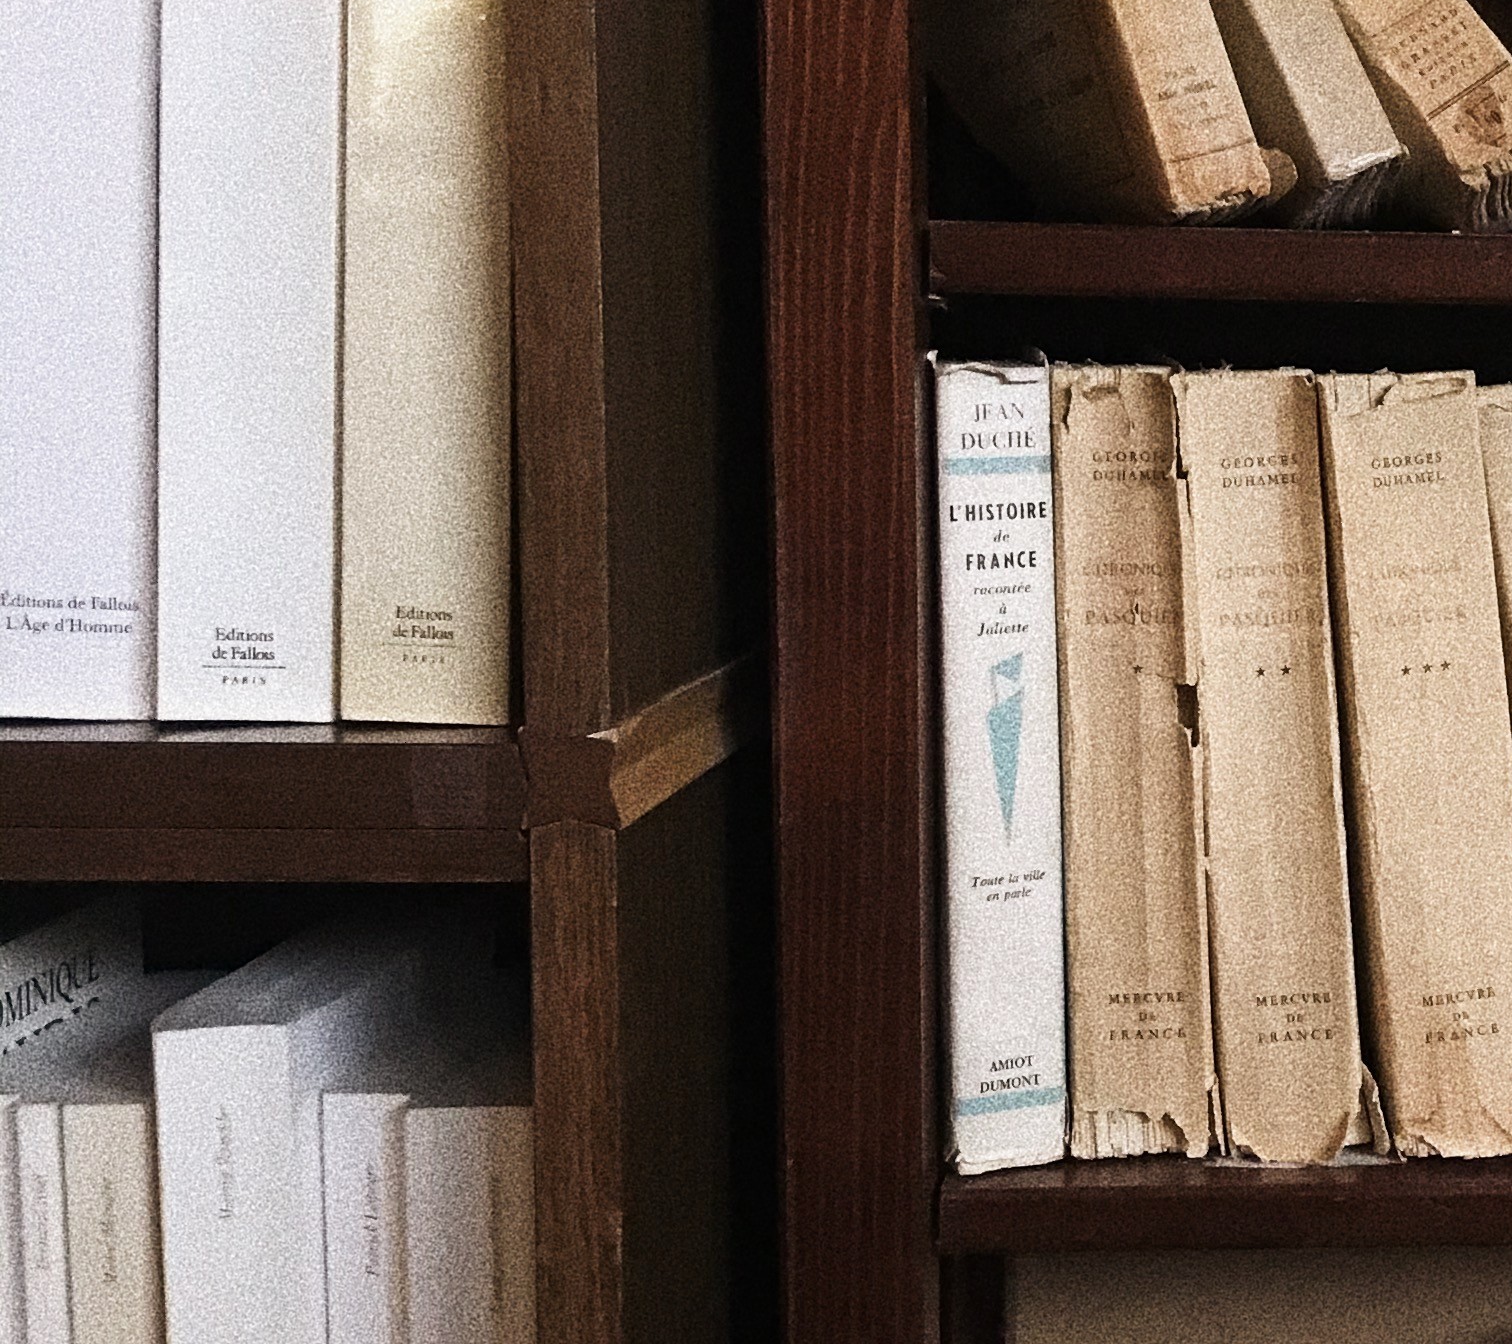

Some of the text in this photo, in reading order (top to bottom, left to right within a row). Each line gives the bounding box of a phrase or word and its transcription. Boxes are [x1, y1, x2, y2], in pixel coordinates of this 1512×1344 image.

[974, 403, 1024, 422] JEAN
[961, 426, 1037, 451] DUCHÉ
[1220, 454, 1299, 470] GEORGES
[1370, 452, 1443, 470] GEORGES
[1222, 471, 1299, 488] DUHAMEL
[1371, 470, 1446, 489] DUHAMEL
[950, 500, 1047, 523] L'HISTOIRE
[993, 529, 1010, 543] de
[965, 550, 1038, 570] FRANCE
[973, 581, 1032, 596] racontée
[67, 594, 86, 610] de
[999, 602, 1008, 615] à
[54, 617, 133, 634] d'Homme
[977, 620, 1030, 637] Juliette
[211, 646, 227, 661] de
[972, 869, 1046, 888] Toute la ville
[986, 887, 1032, 903] en parle
[1255, 992, 1333, 1007] MERCVRE
[1421, 986, 1497, 1008] MERCVRE
[1108, 1027, 1188, 1040] FRANCE
[1257, 1029, 1334, 1044] FRANCE
[1424, 1023, 1501, 1044] FRANCE
[989, 1054, 1035, 1073] AMIOT
[979, 1074, 1041, 1094] DUMONT
